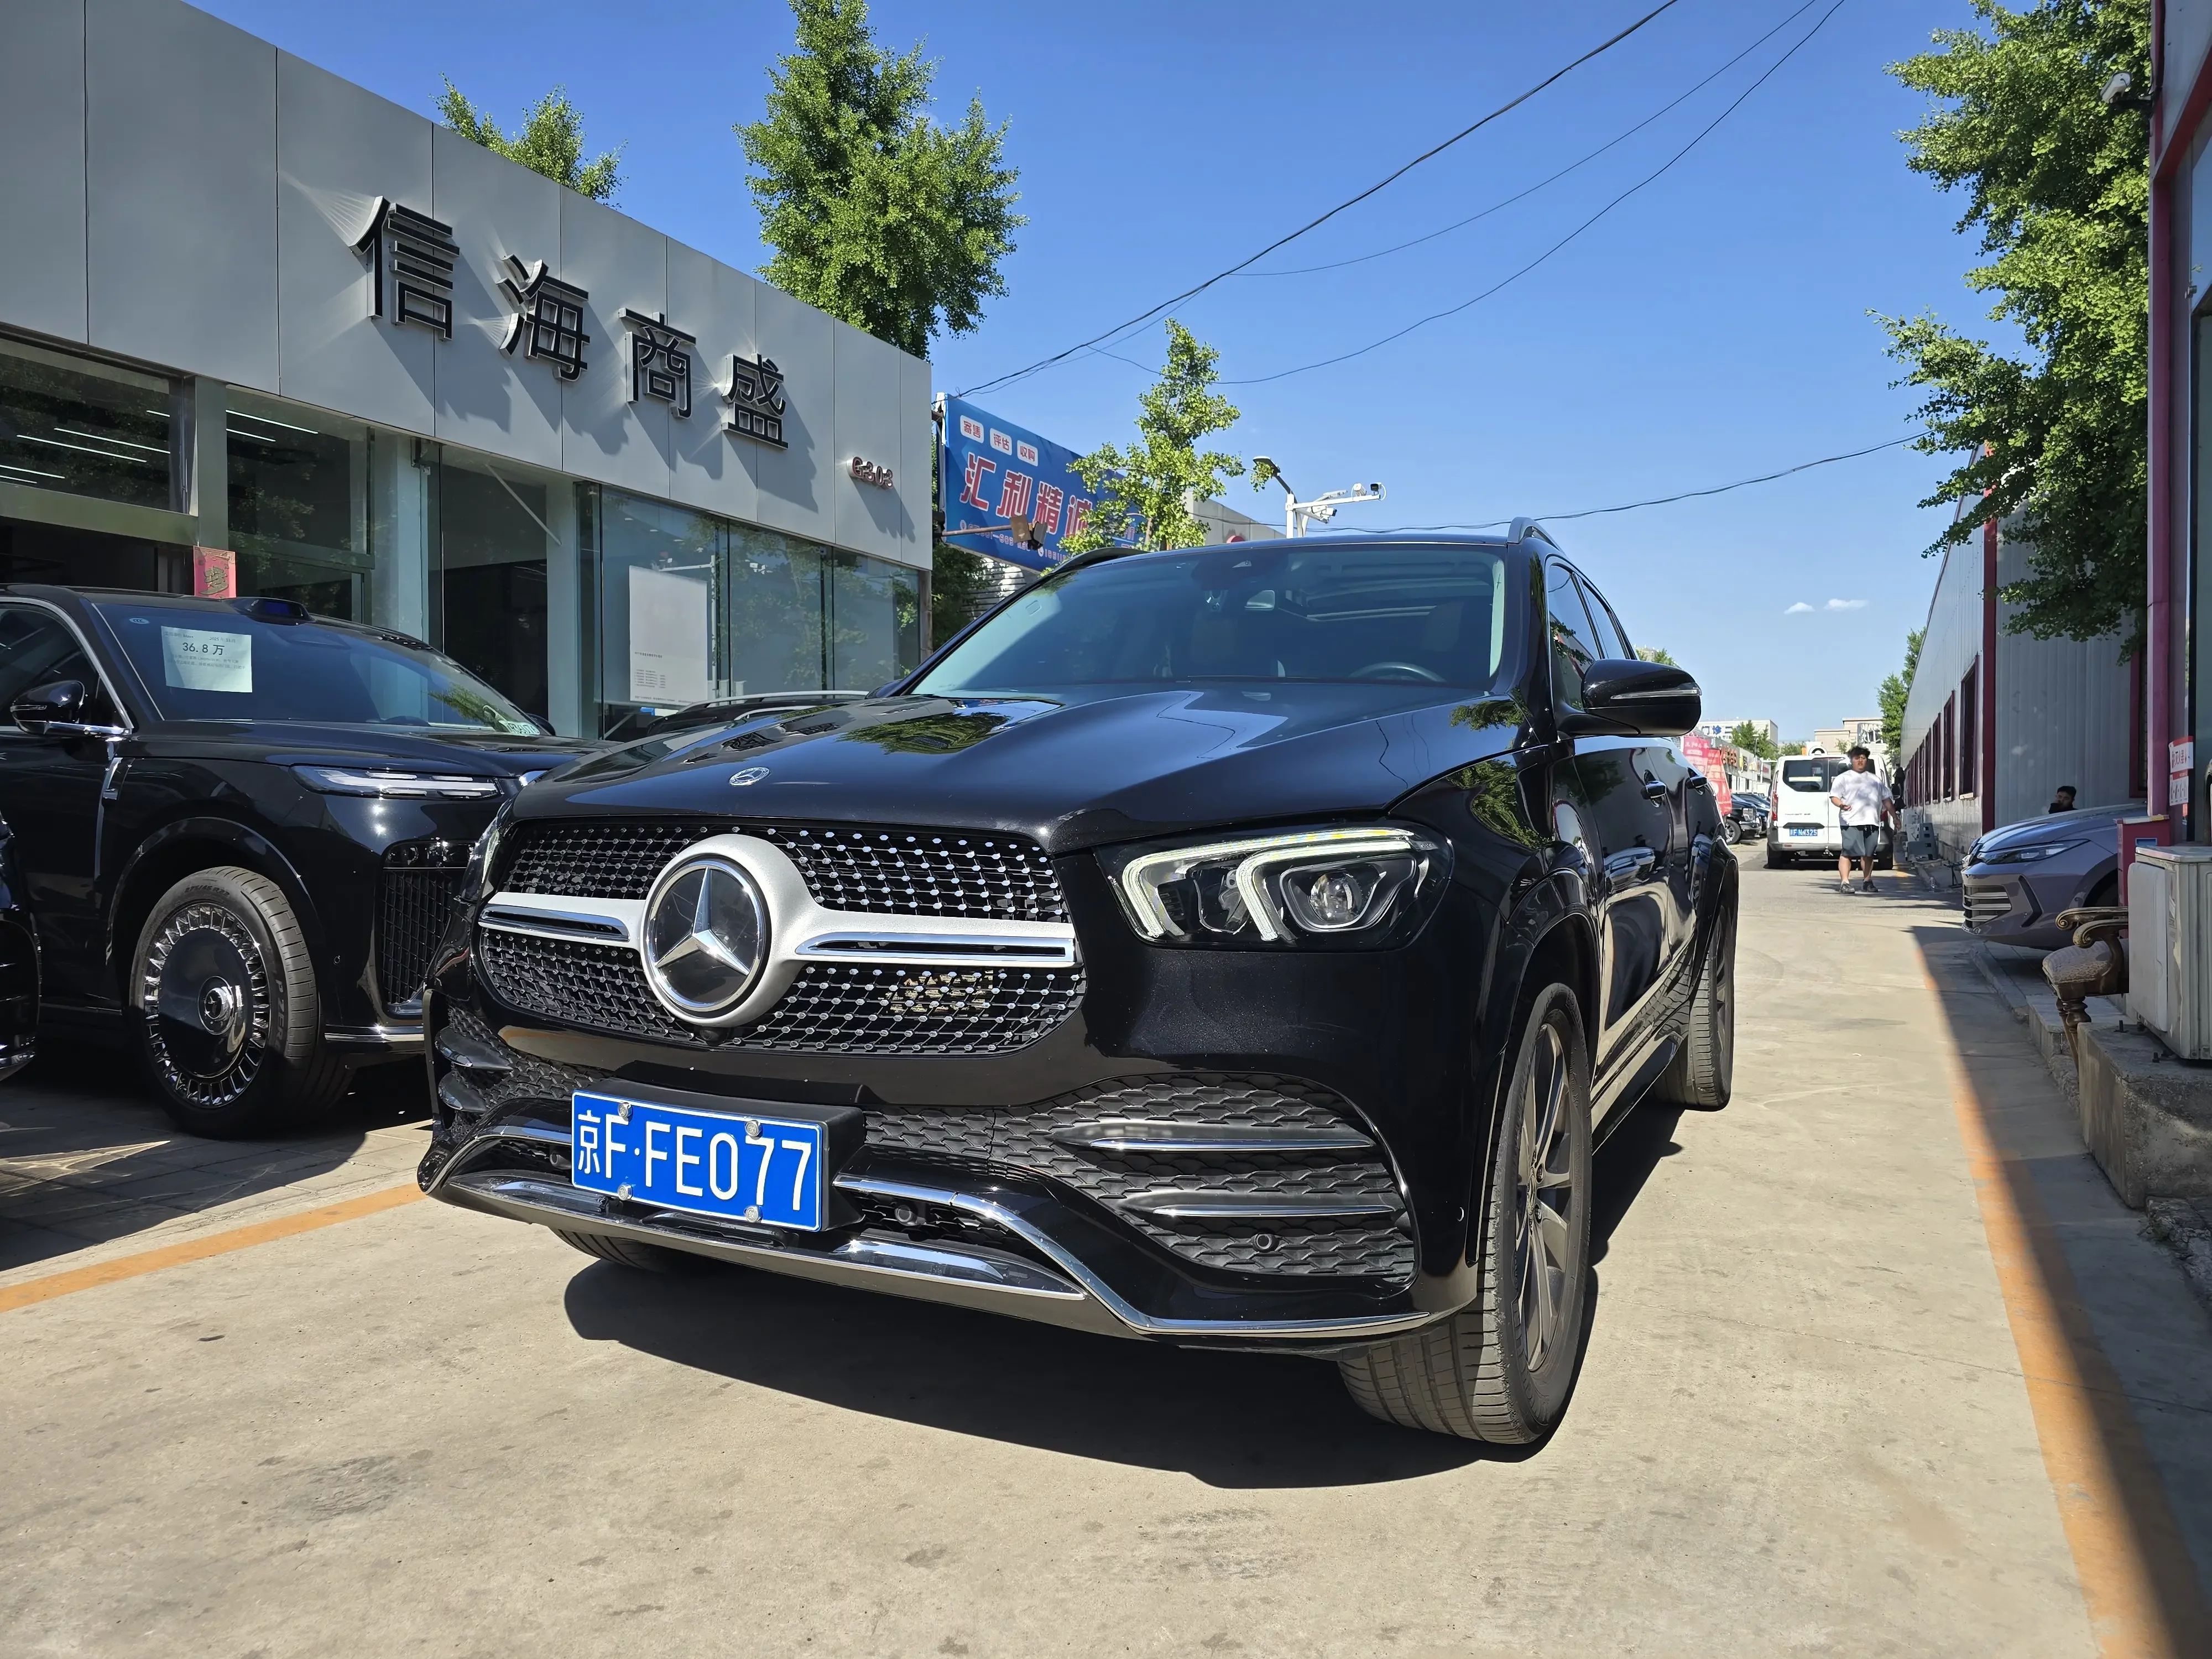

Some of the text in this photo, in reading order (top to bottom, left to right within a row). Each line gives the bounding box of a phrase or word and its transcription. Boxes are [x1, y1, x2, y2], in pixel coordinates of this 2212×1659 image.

[349, 195, 789, 450] 信海商盛
[993, 433, 1010, 451] 评估
[1020, 445, 1036, 462] 收购
